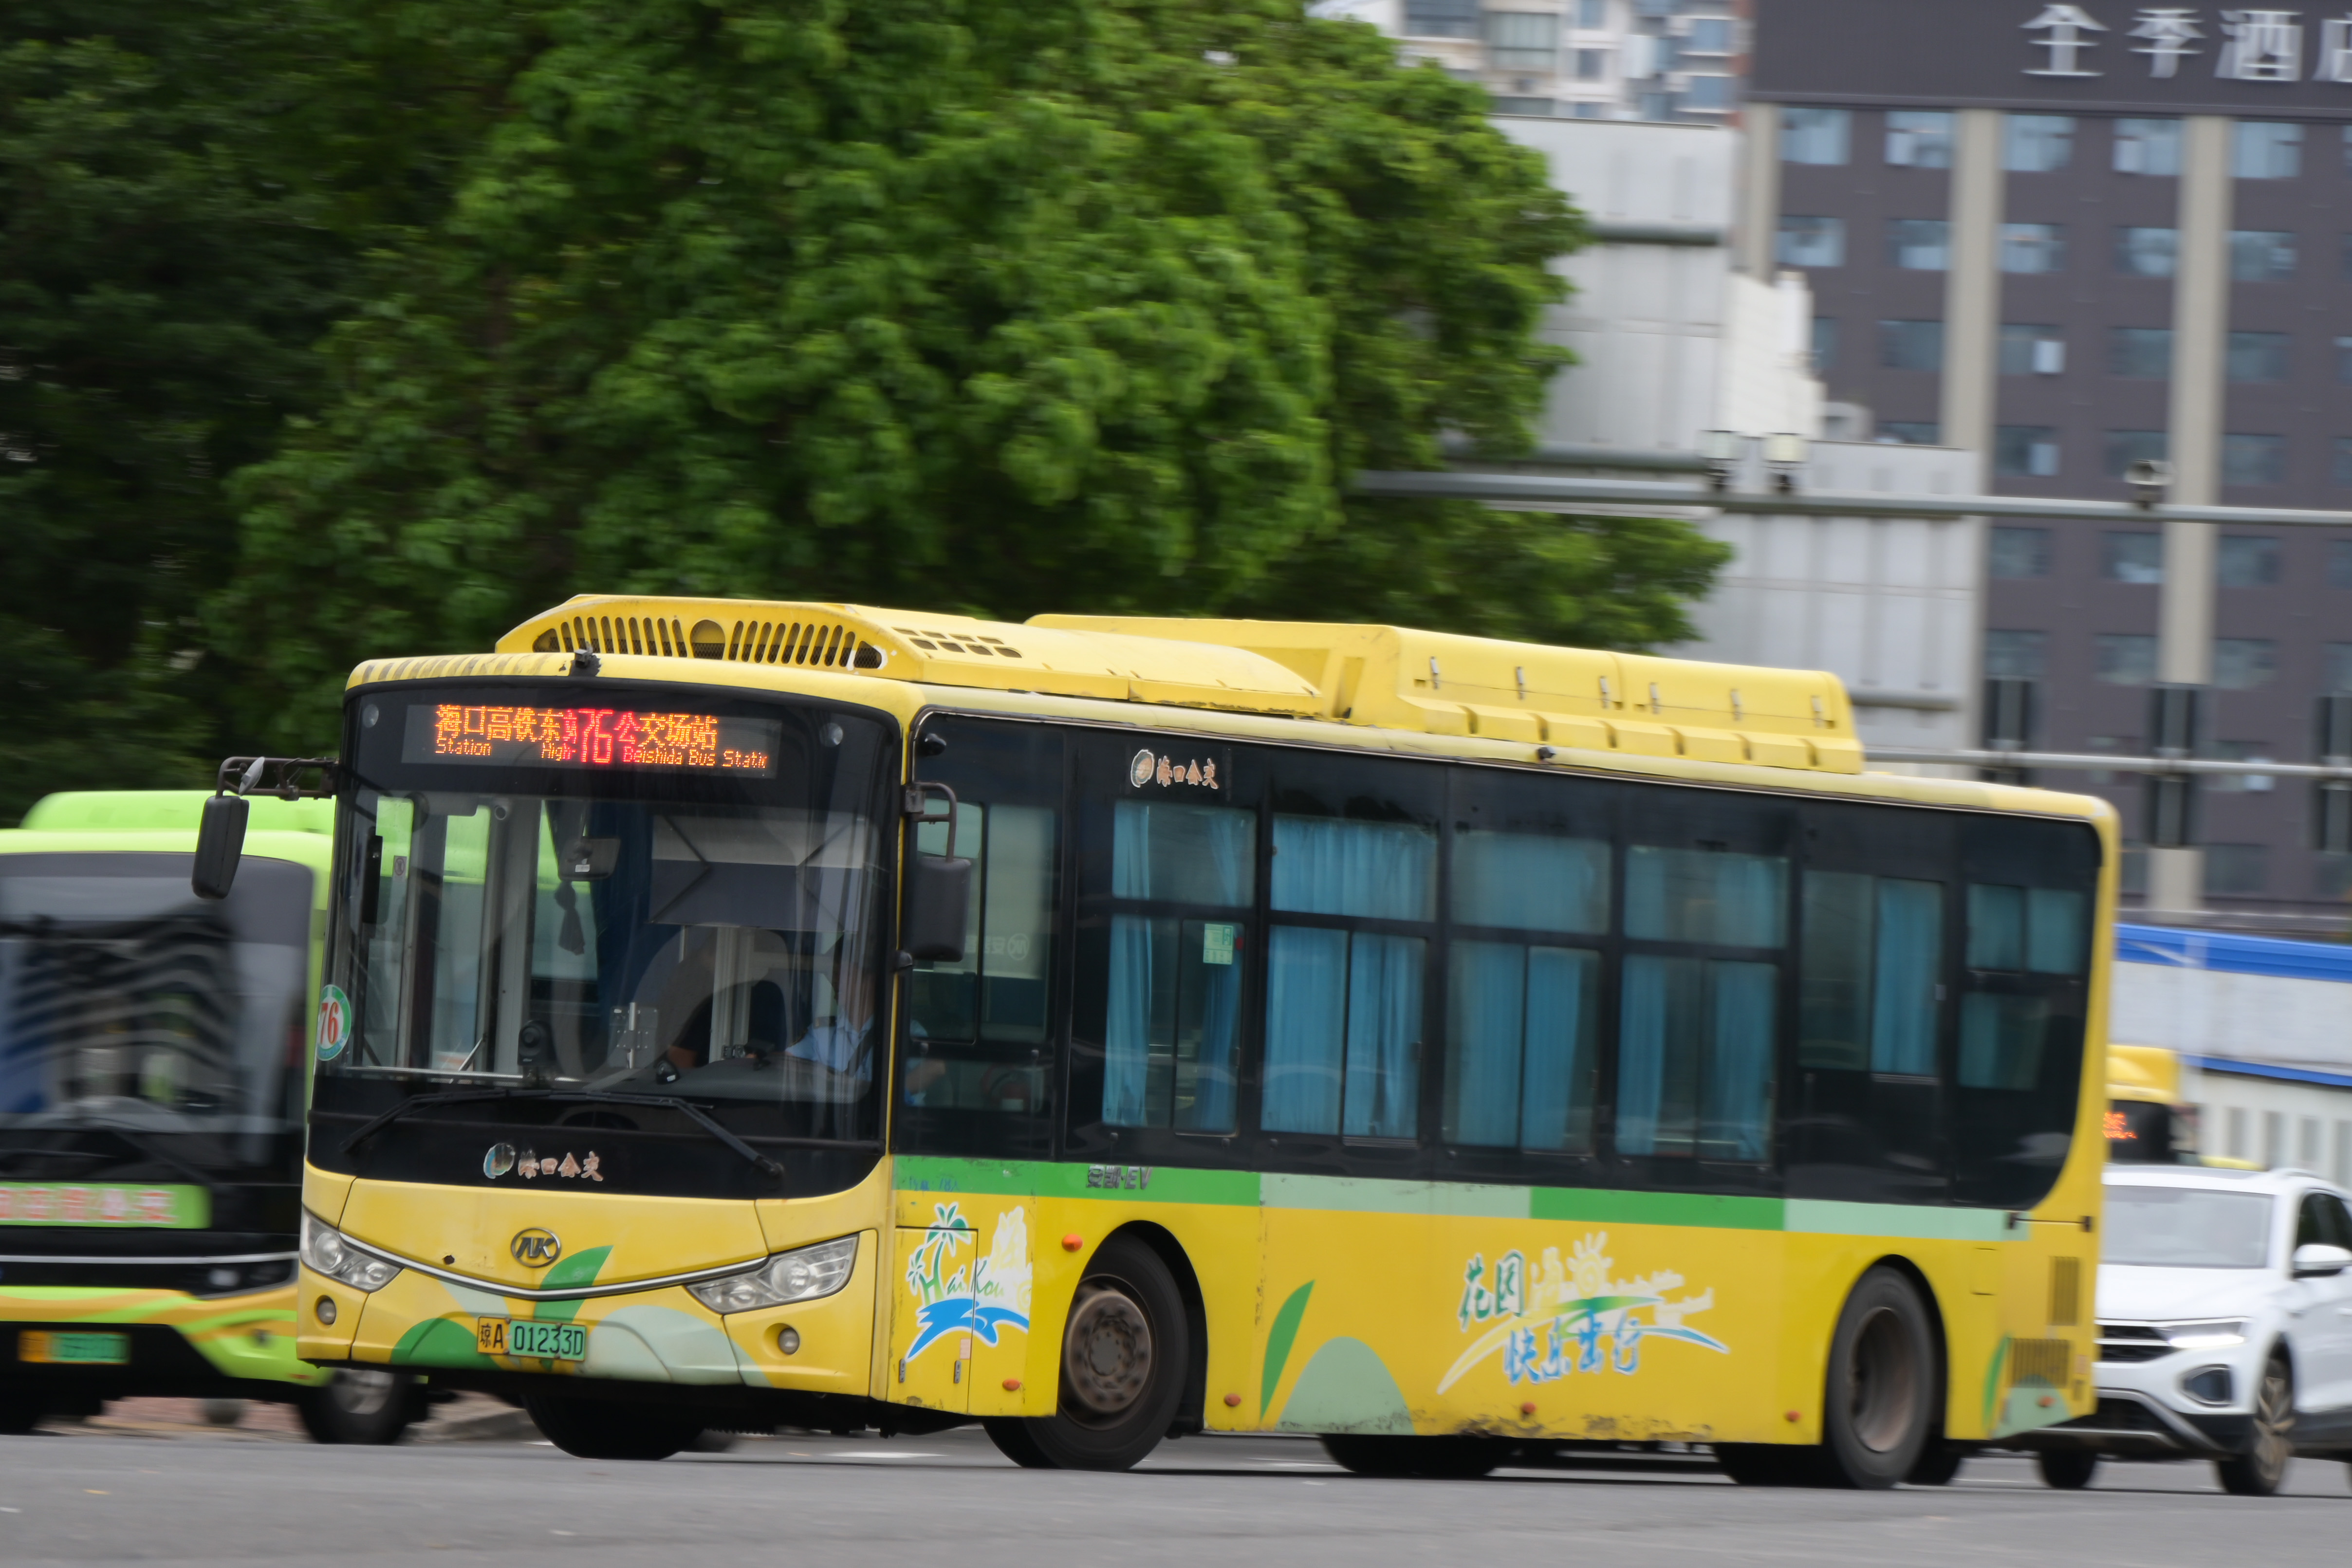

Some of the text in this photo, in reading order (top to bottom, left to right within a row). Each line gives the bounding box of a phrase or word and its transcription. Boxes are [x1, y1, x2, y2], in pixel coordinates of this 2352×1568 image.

[435, 738, 492, 756] Station
[622, 746, 683, 765] Beishida
[688, 748, 716, 767] Bus
[578, 708, 614, 764] 76
[320, 1001, 339, 1045] 76
